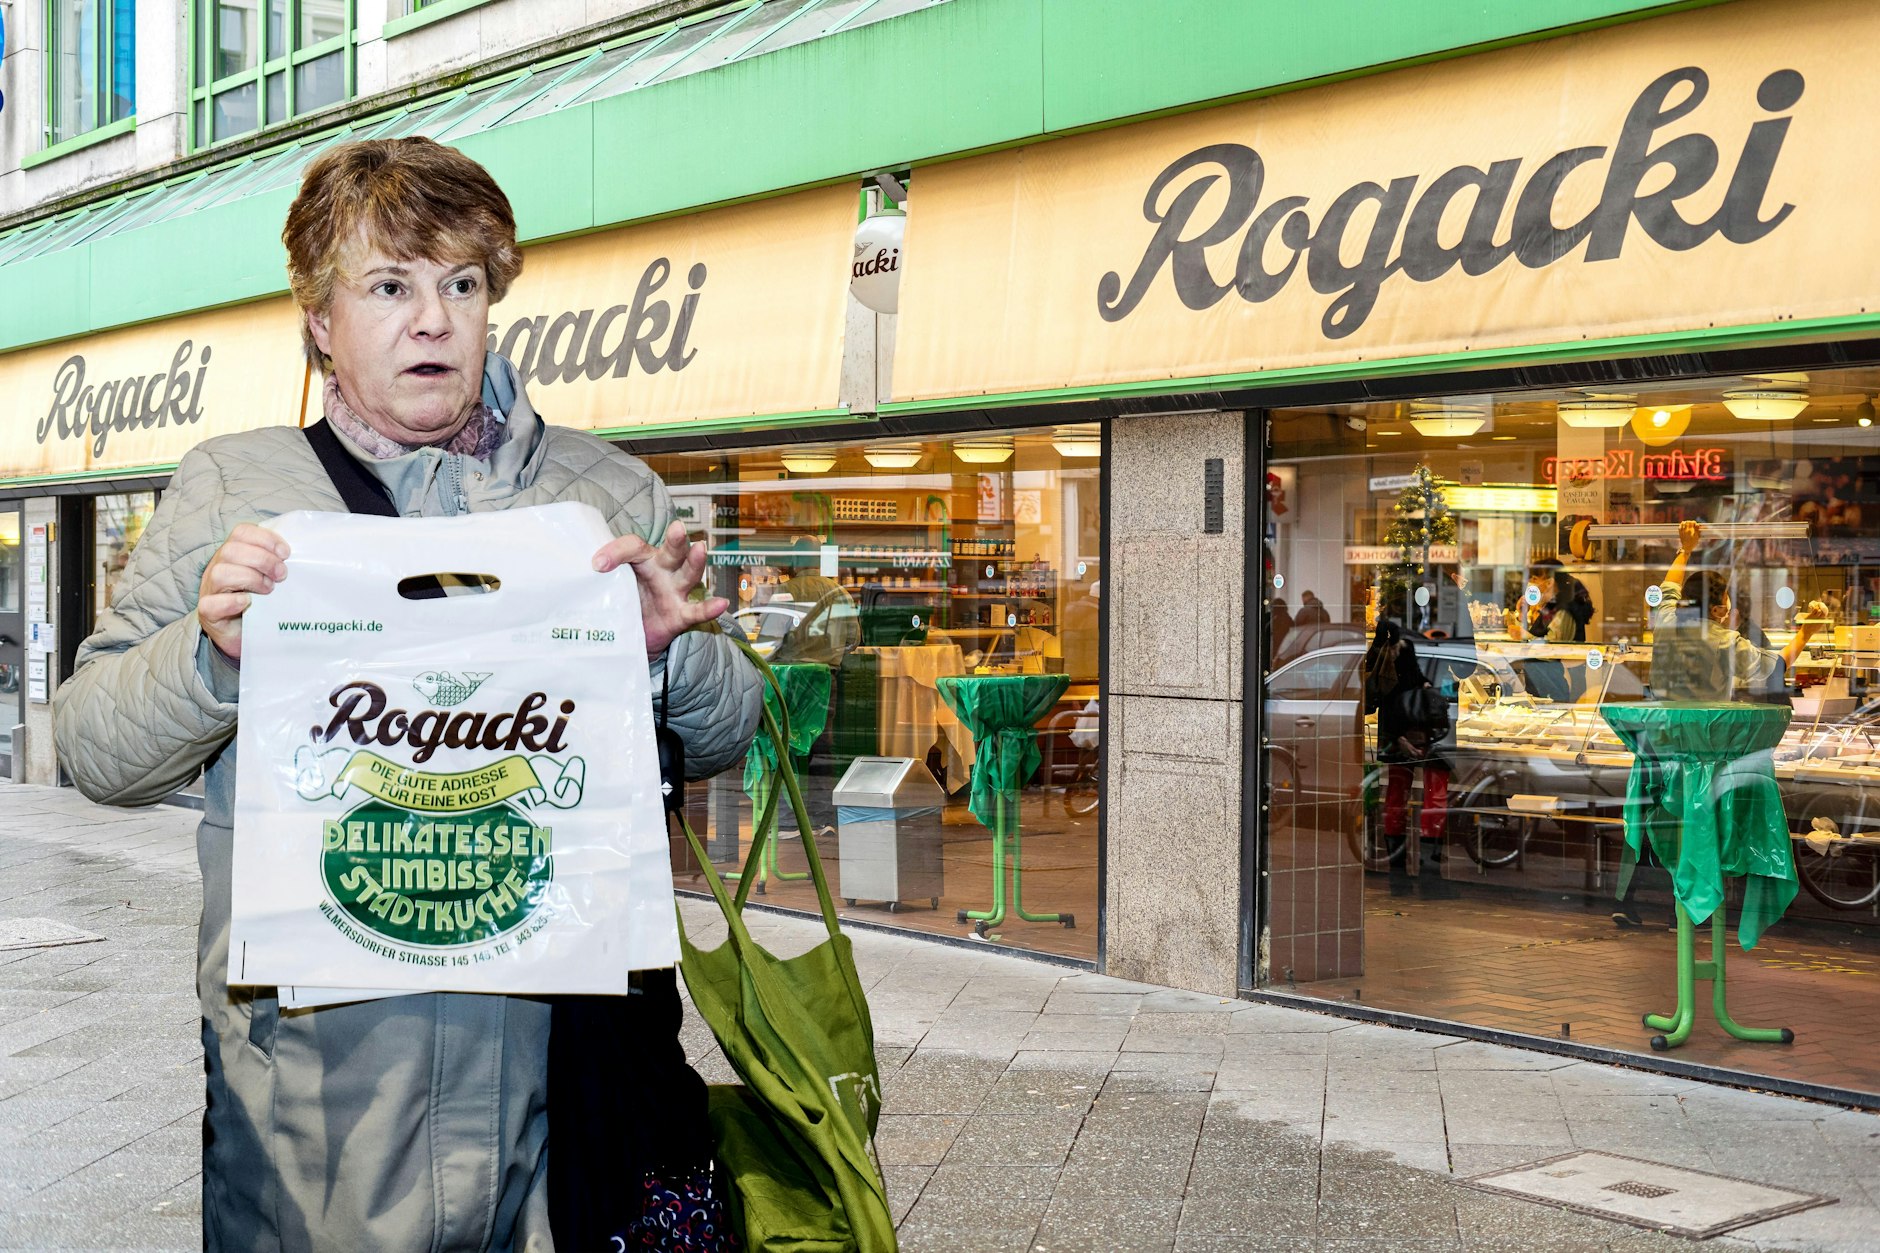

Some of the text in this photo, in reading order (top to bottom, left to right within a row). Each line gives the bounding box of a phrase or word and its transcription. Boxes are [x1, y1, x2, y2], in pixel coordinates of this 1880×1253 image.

[1098, 65, 1805, 339] Rogacki
[851, 248, 899, 284] acki
[36, 339, 212, 459] Rogacki
[278, 619, 383, 634] www.rogacki.de
[551, 627, 582, 640] SEIT
[585, 629, 615, 642] 1928
[309, 681, 576, 764] Rogacki
[370, 760, 508, 791] DIE GUTE ADRESSE
[379, 781, 497, 807] FÜR FEINE KOST
[323, 819, 553, 856] DELIKATESSEN
[382, 858, 494, 890] IMBISS
[339, 865, 529, 932] STADTKÜCHE
[318, 899, 396, 960] WILMERSDORFER
[398, 950, 448, 967] STRASSE
[515, 928, 532, 945] 343
